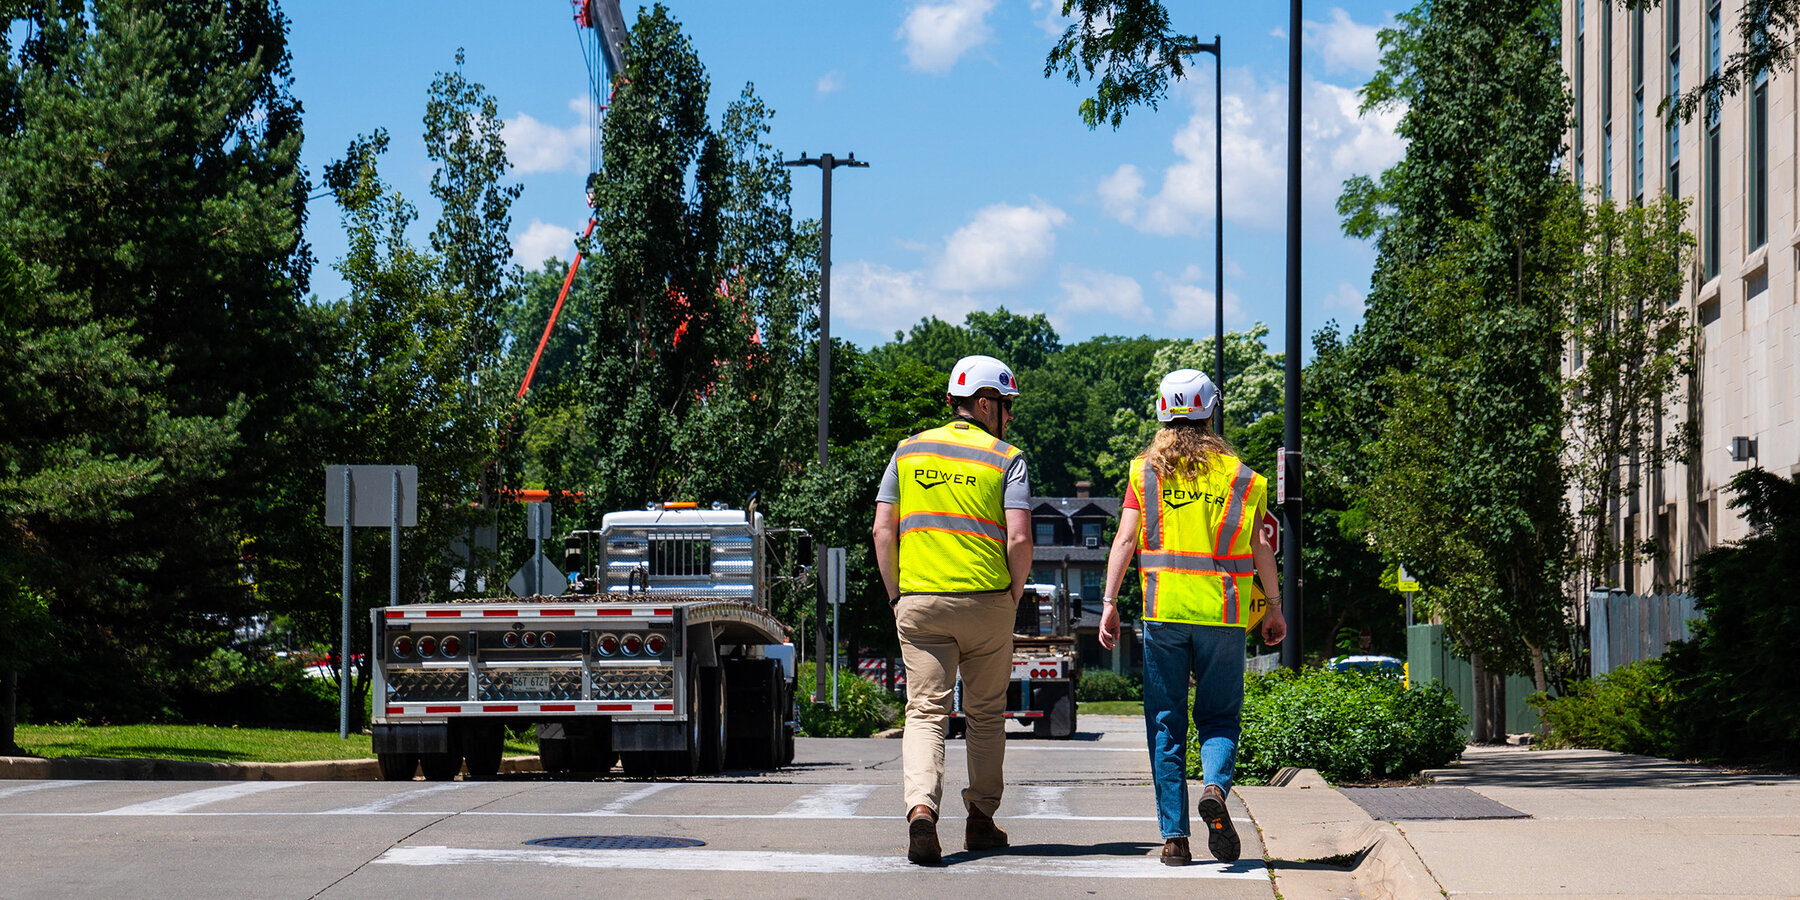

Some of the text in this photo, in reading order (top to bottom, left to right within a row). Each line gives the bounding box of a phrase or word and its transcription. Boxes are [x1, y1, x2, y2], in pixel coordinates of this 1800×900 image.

[1174, 392, 1184, 406] N
[914, 469, 977, 487] POWER
[1162, 489, 1226, 508] POWER
[1249, 598, 1266, 613] MP
